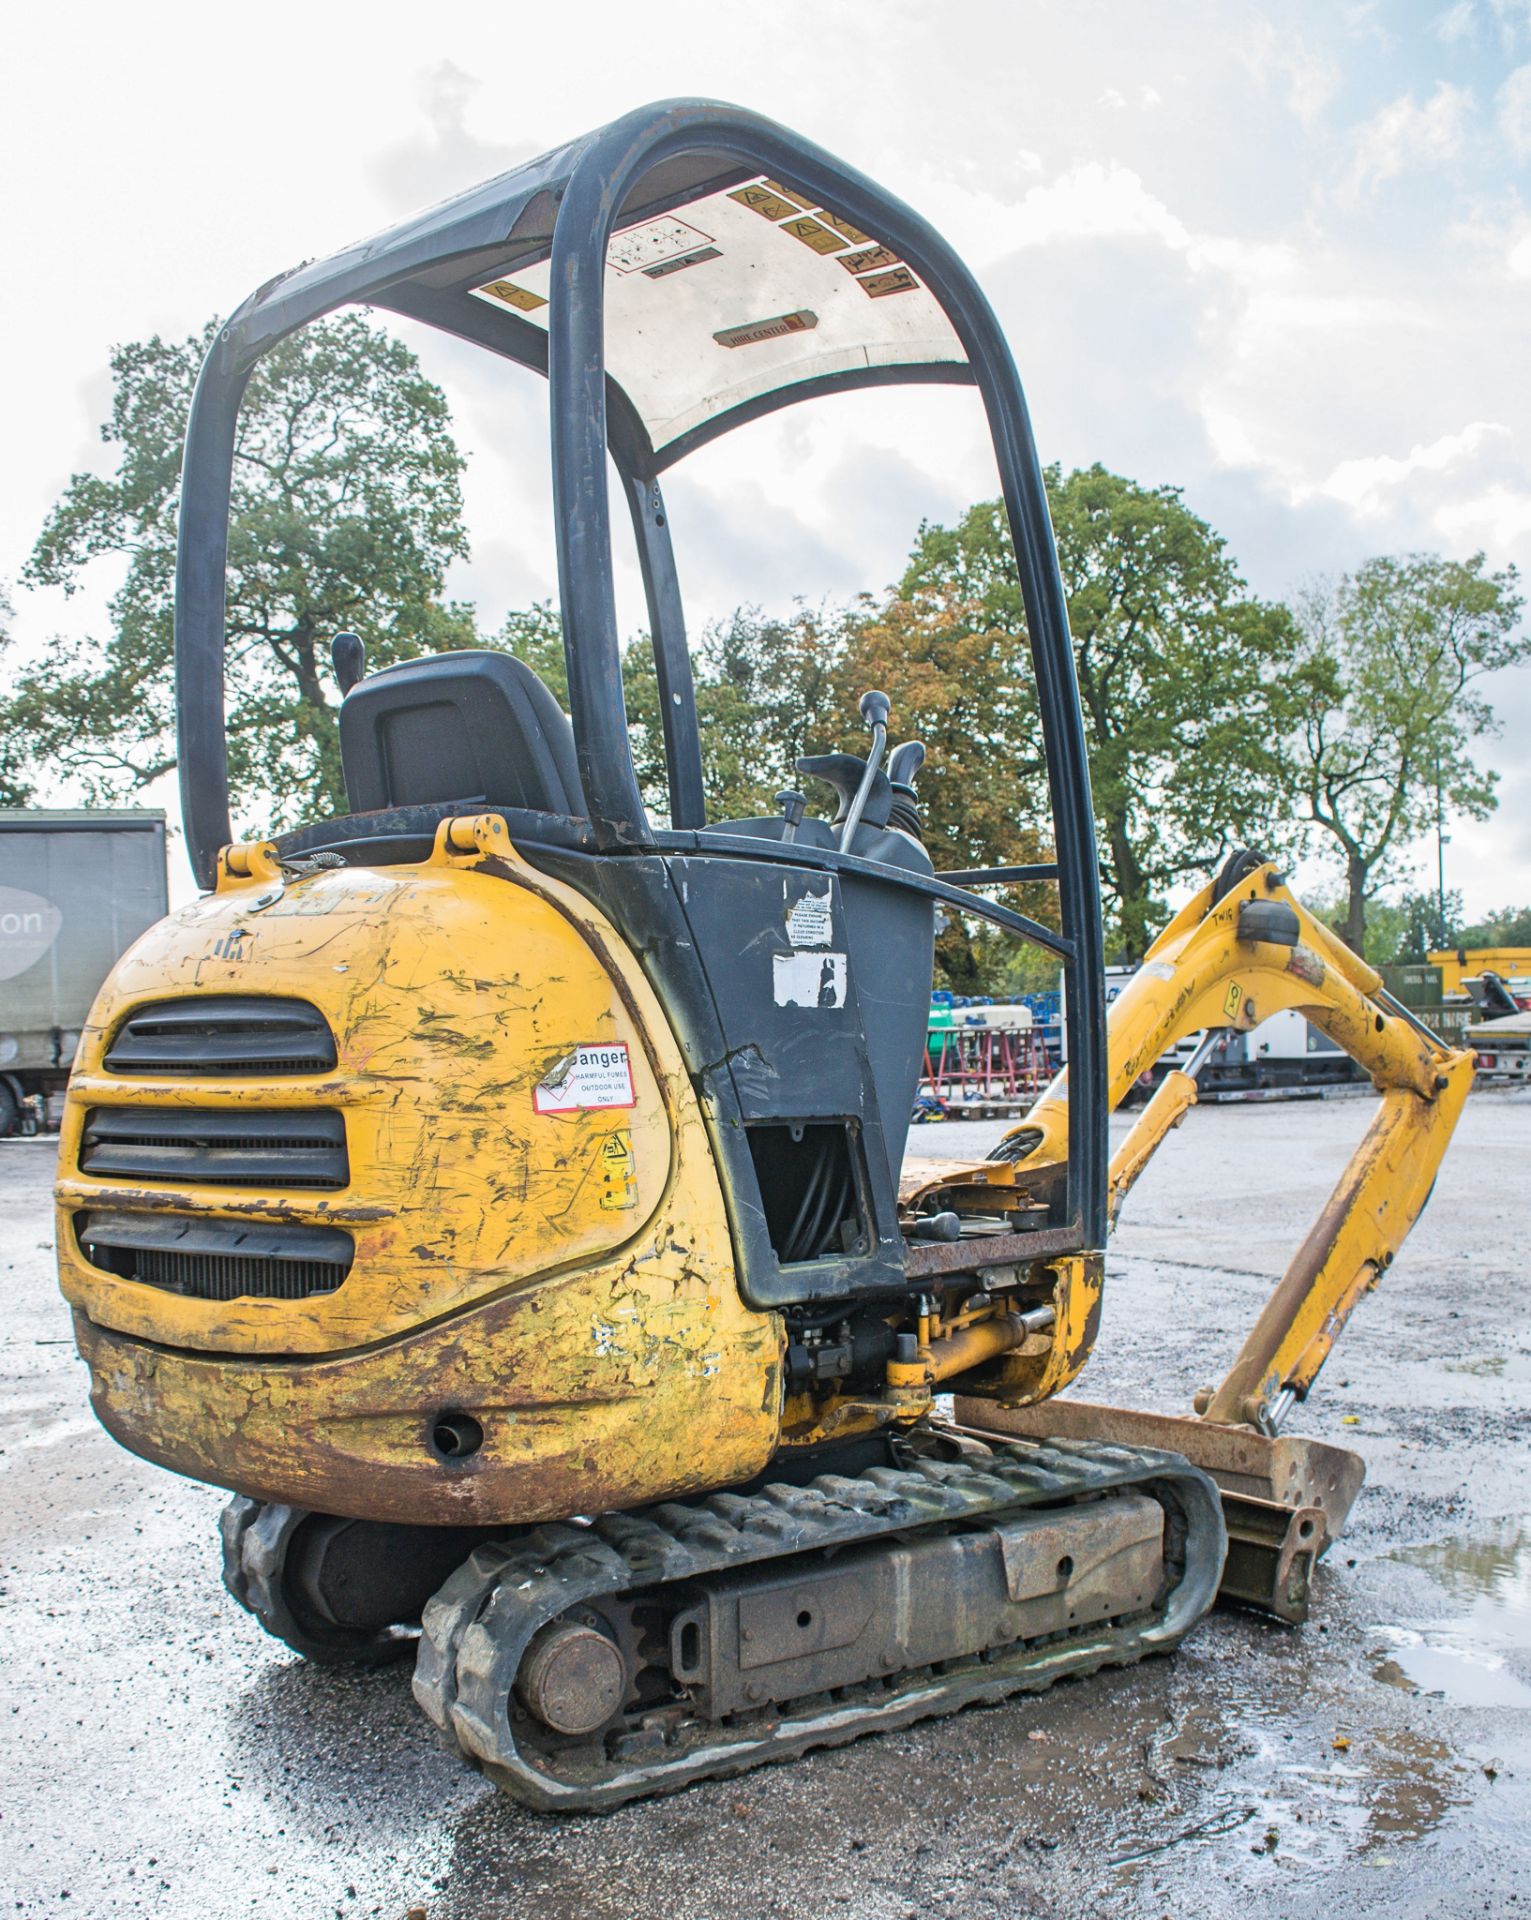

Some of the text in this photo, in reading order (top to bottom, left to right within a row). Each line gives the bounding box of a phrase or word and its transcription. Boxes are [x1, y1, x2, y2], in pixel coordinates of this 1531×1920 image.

[730, 325, 789, 345] HIRE CENTER
[581, 1083, 612, 1091] OUTDOOR
